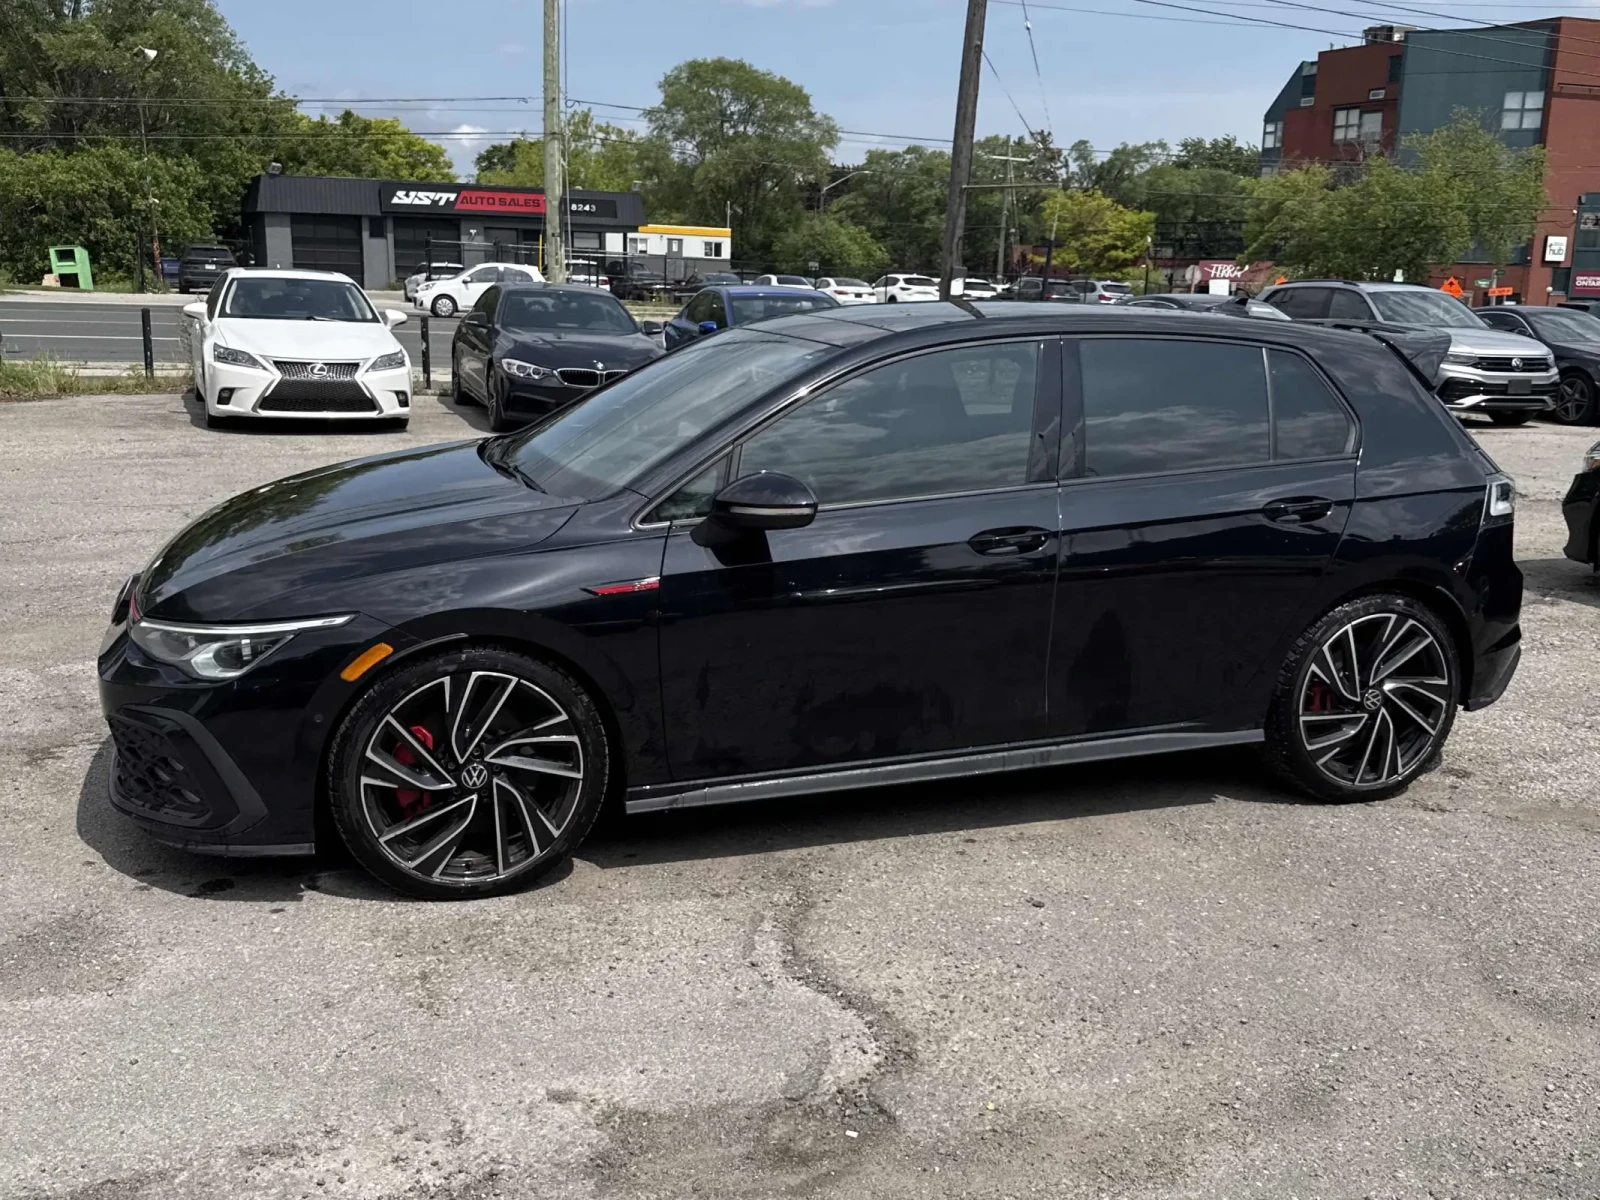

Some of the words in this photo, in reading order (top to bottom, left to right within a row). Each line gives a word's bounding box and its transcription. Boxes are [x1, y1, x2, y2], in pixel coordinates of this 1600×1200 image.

[460, 196, 496, 206] AUTO
[498, 197, 540, 208] SALES
[571, 203, 596, 212] 8243
